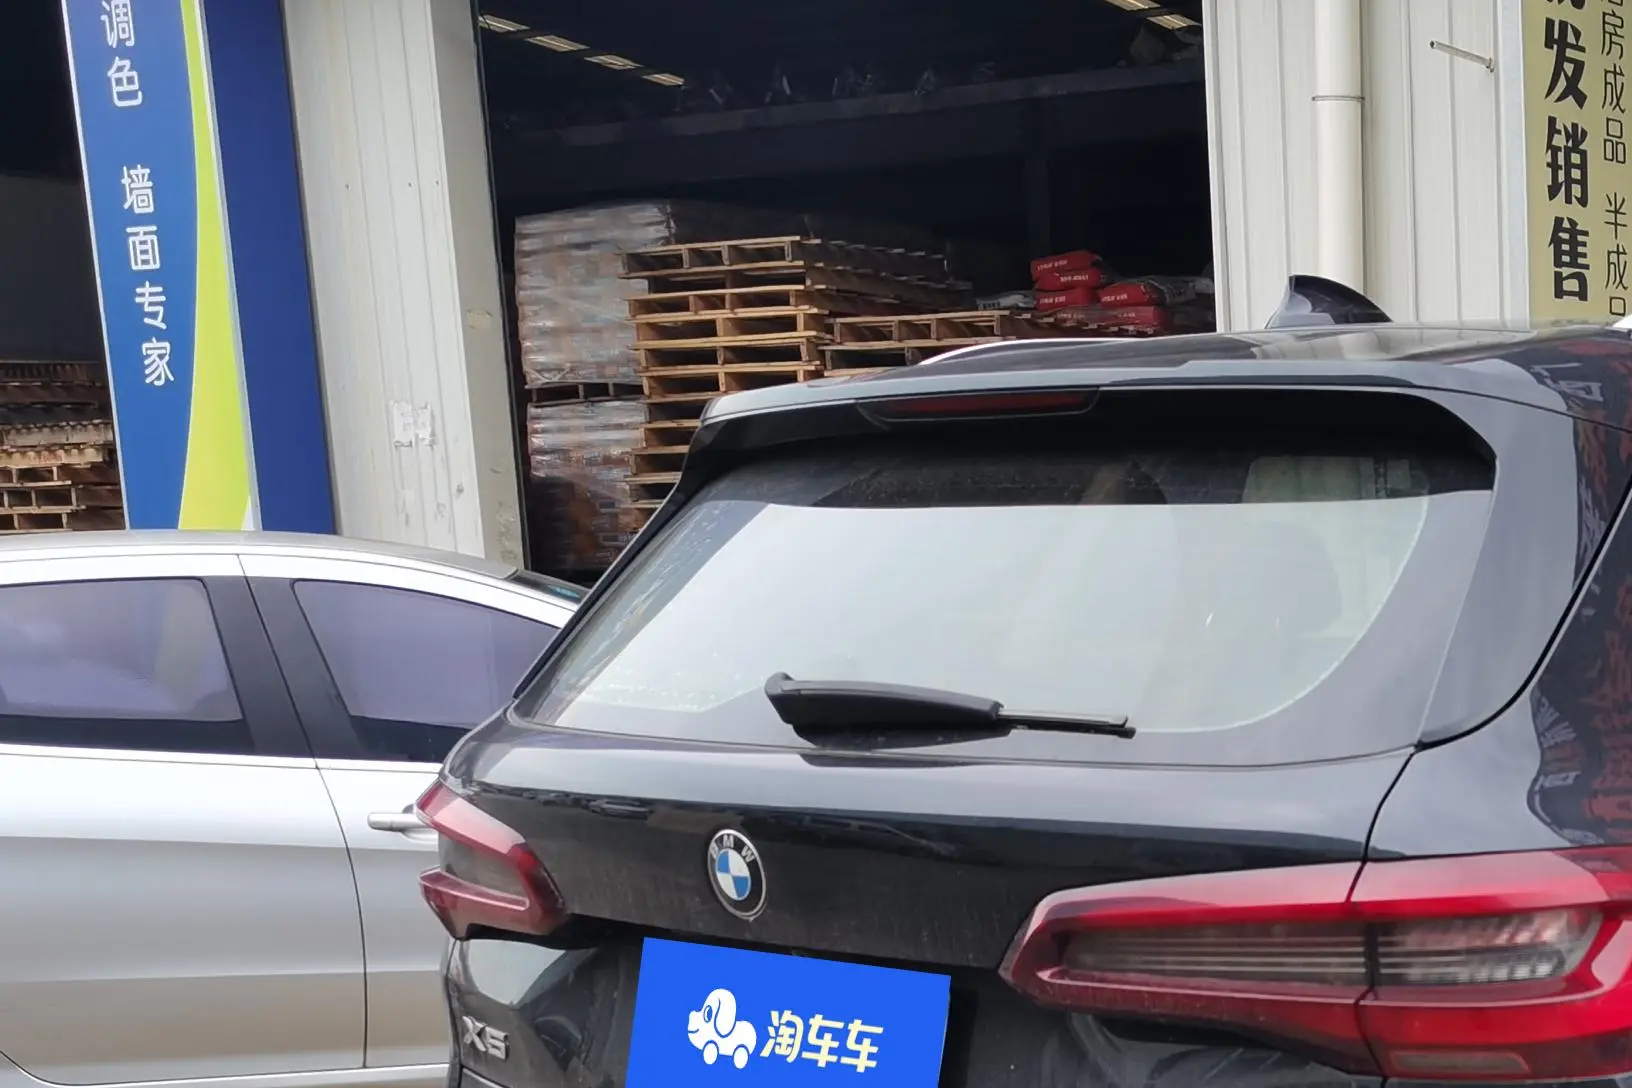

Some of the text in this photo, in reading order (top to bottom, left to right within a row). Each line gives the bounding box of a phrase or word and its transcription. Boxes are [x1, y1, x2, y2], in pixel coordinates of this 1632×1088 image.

[1544, 0, 1590, 302] 发销售
[1601, 0, 1627, 165] 房成品
[101, 0, 175, 386] 调色 墙面专家
[709, 834, 756, 862] BMW
[462, 1015, 510, 1061] X5
